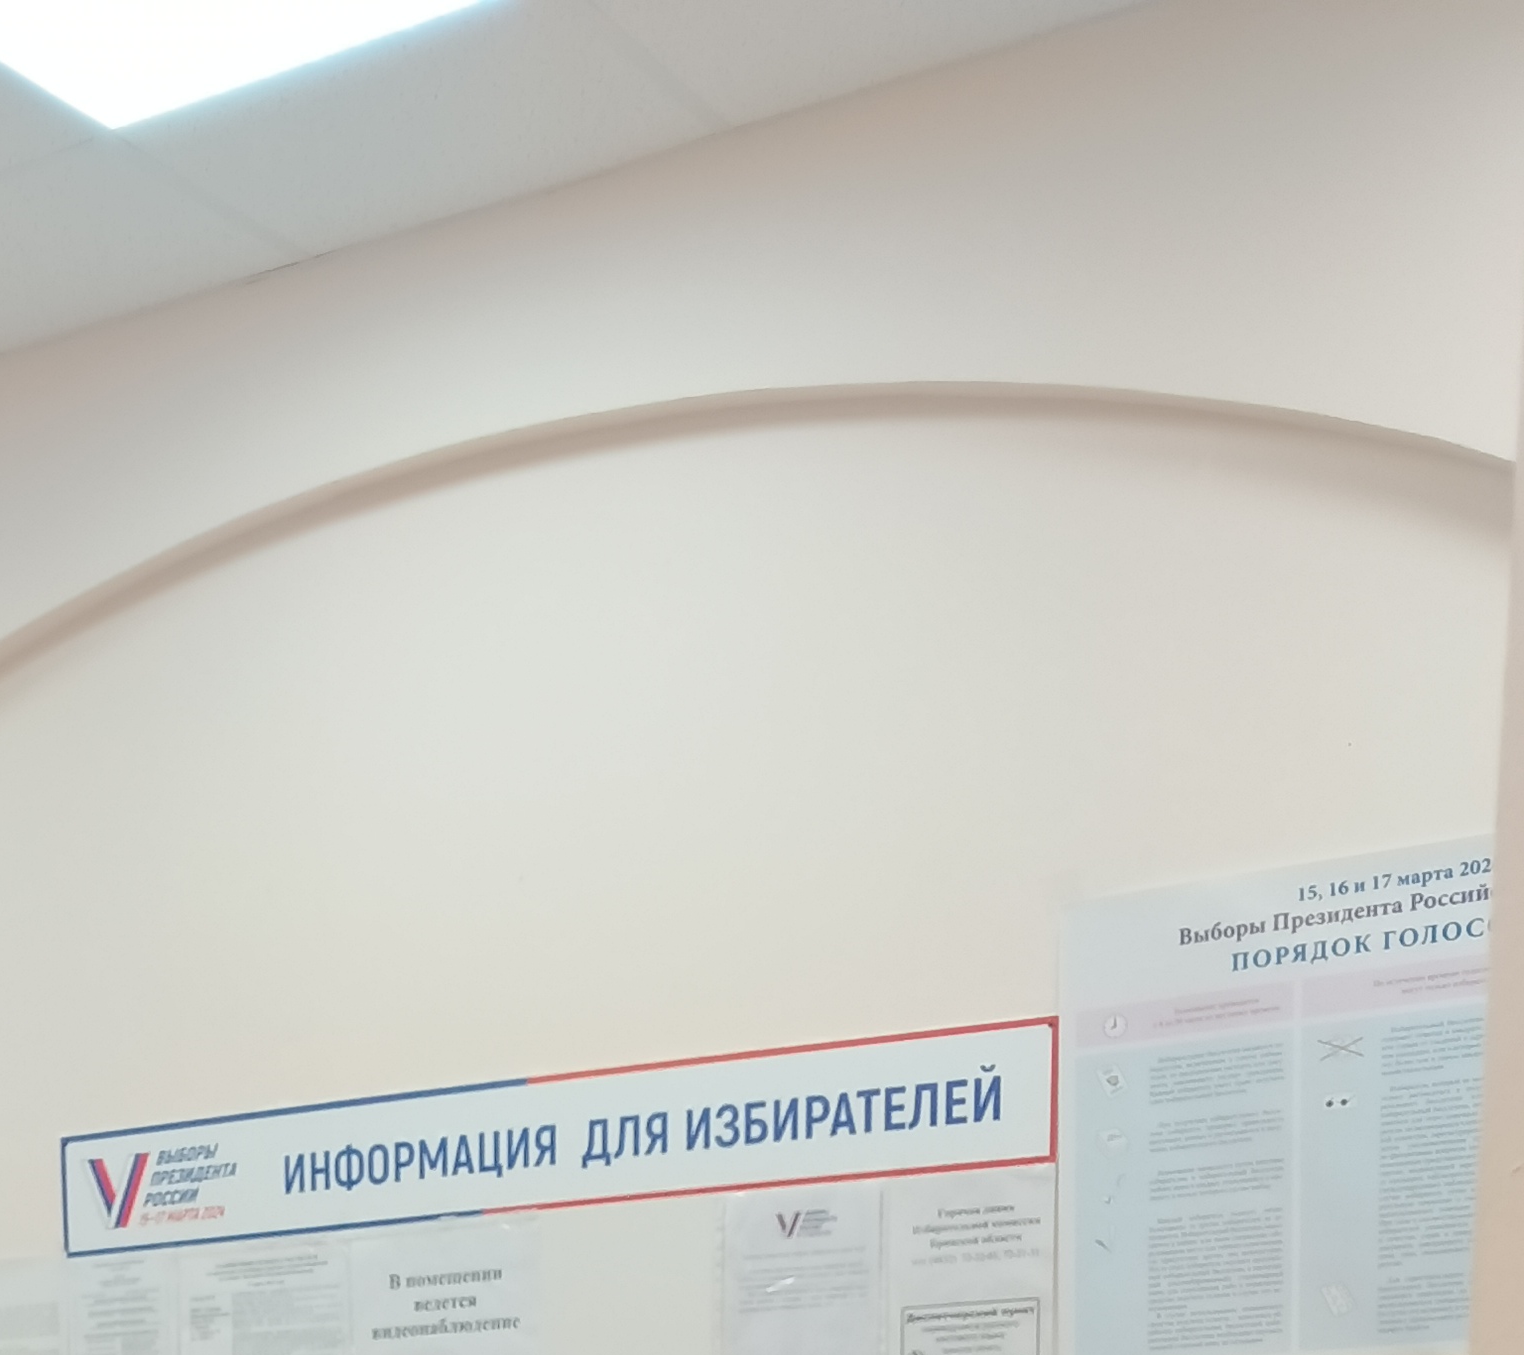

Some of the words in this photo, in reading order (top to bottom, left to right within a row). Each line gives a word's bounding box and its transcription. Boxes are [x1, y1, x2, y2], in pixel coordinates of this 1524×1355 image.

[1298, 886, 1323, 901] 15,
[1330, 879, 1350, 897] 16
[1354, 881, 1365, 893] и
[1372, 873, 1393, 890] 17
[1396, 867, 1454, 889] марта
[1179, 920, 1267, 946] Выборы
[1272, 899, 1404, 934] Президента
[1409, 882, 1493, 912] Россий
[1231, 933, 1373, 973] ПОРЯДОК
[1382, 916, 1492, 951] ГОЛОС
[283, 1123, 558, 1195] ИНФОРМАЦИЯ
[581, 1111, 669, 1169] ДЛЯ
[685, 1063, 1002, 1151] ИЗБИРАТЕЛЕЙ
[156, 1142, 219, 1166] ВЫБОРЫ
[150, 1162, 238, 1186] ПРЕЗИДЕНТА
[143, 1185, 200, 1207] РОССИИ
[389, 1273, 401, 1290] В
[405, 1268, 503, 1289] помещении
[371, 1316, 521, 1340] видеонаблюдение
